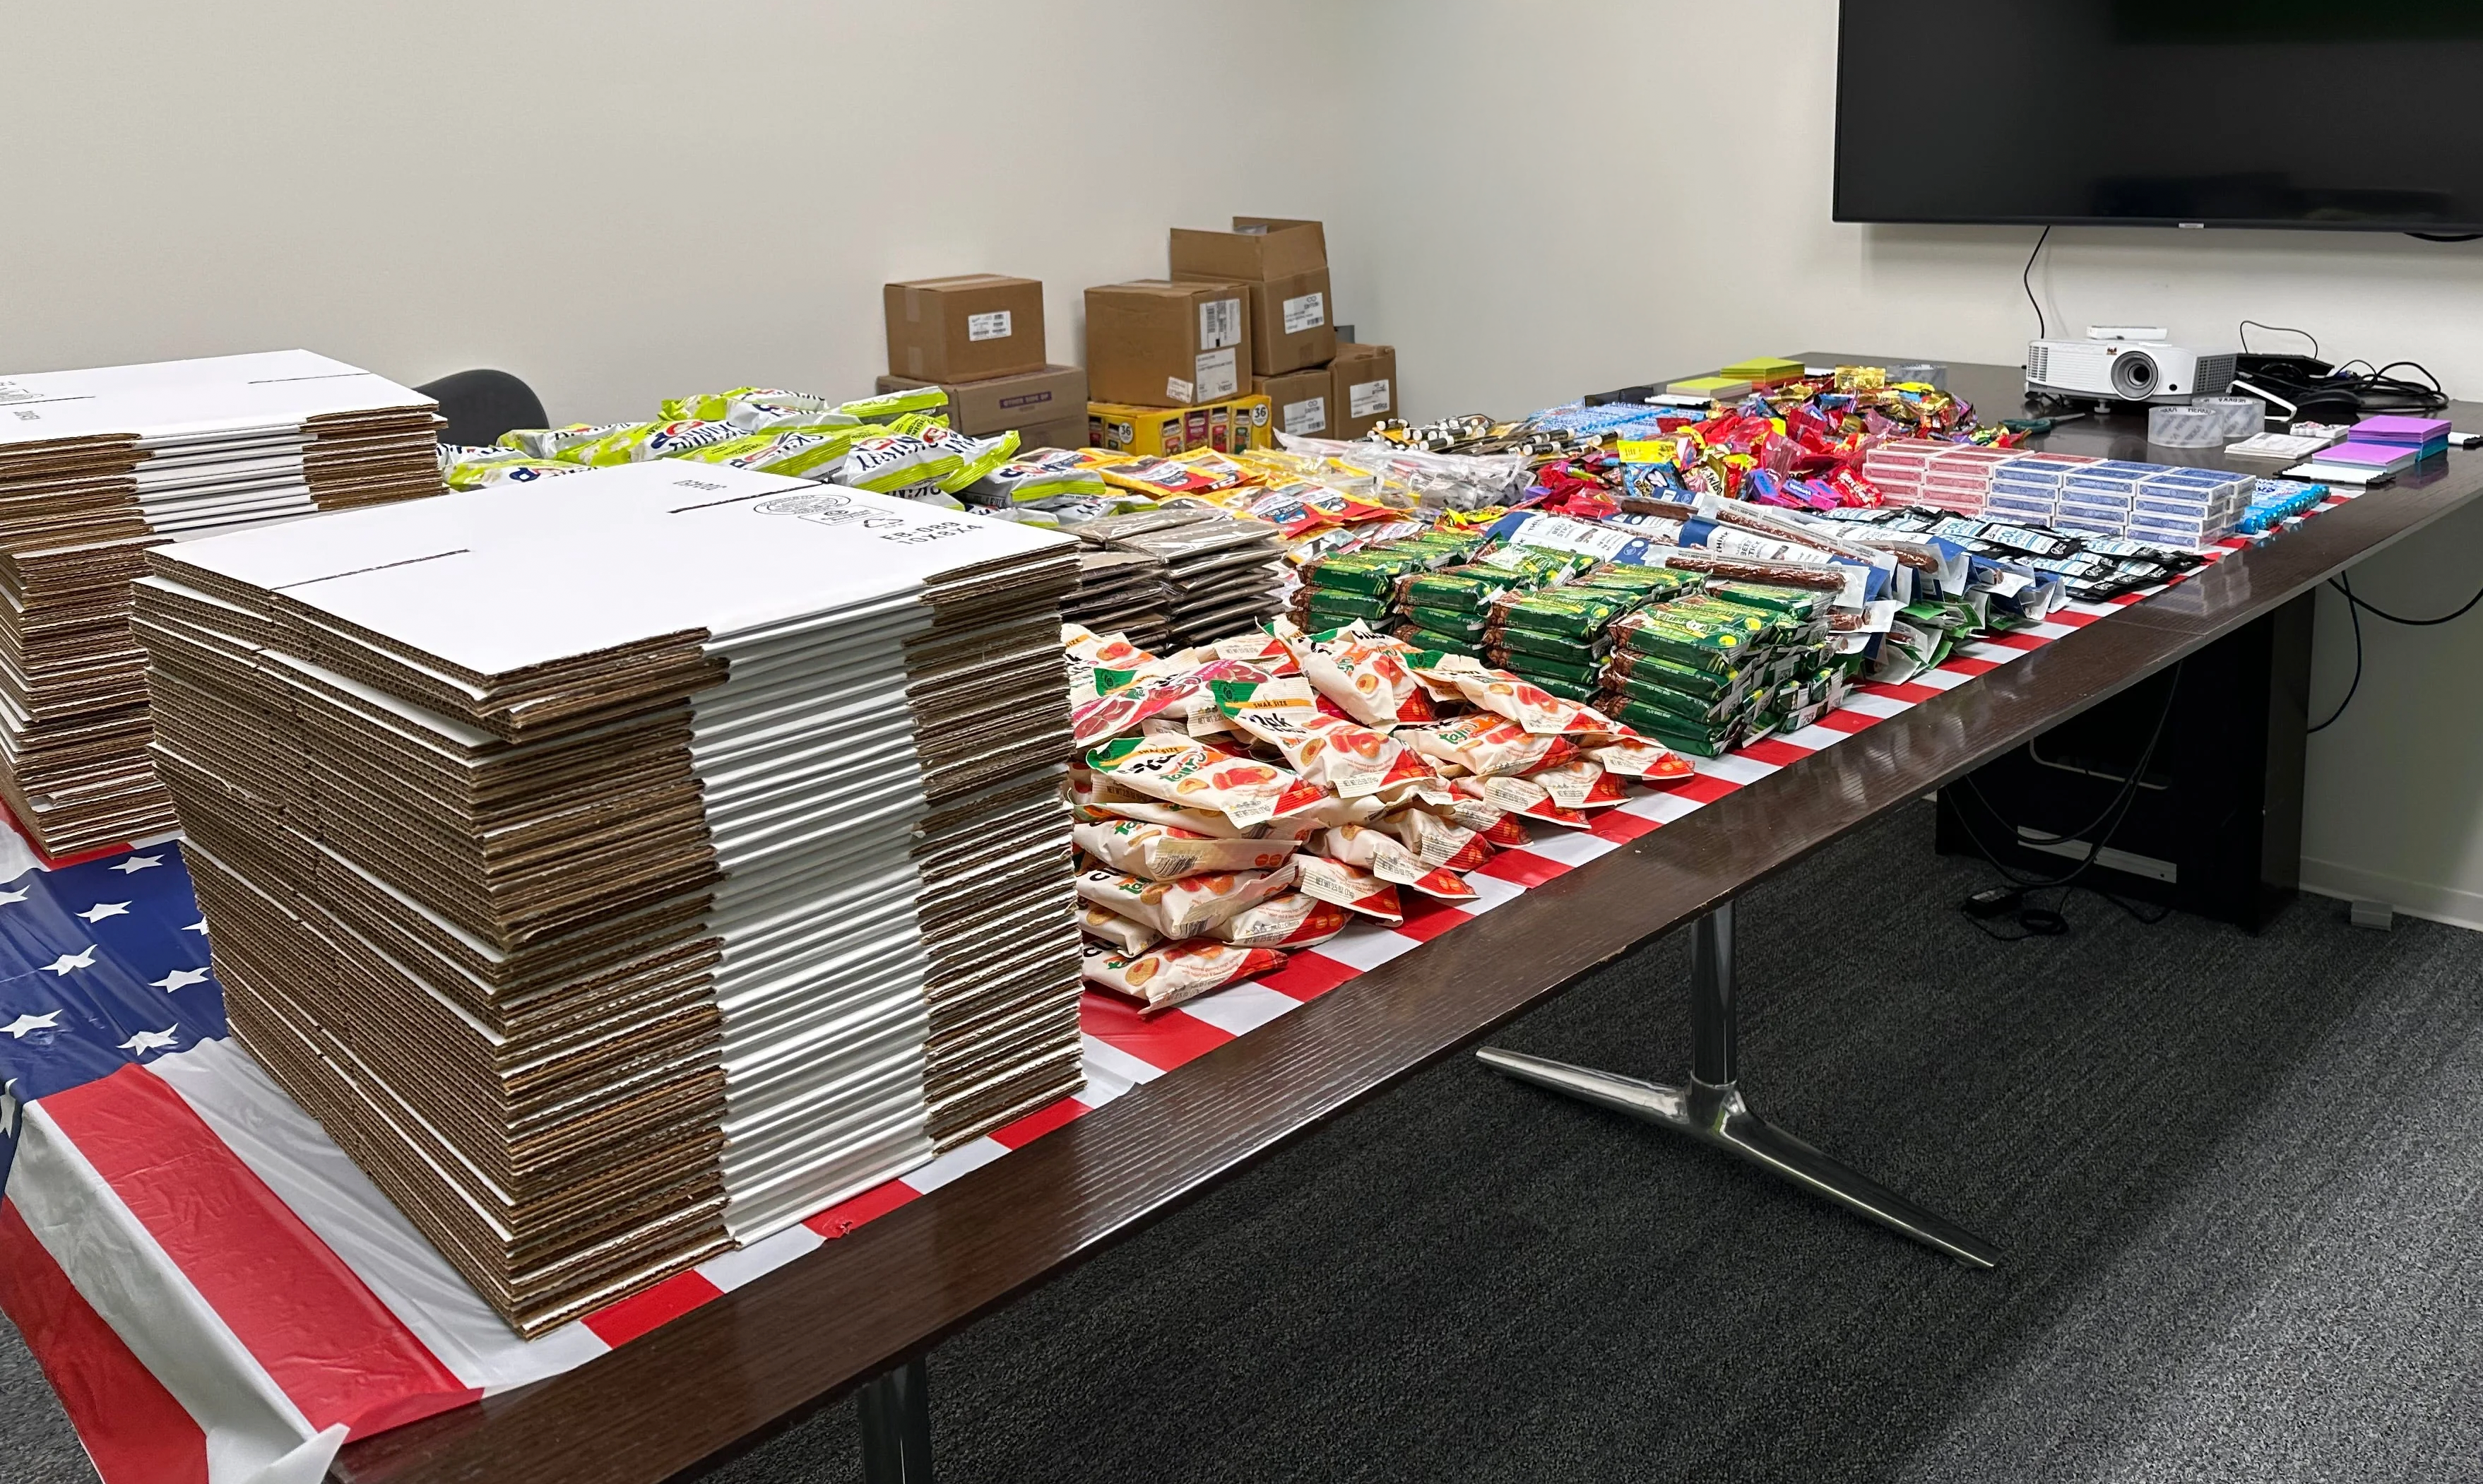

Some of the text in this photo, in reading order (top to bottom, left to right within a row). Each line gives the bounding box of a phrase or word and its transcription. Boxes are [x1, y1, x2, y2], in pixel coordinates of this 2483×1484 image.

[1255, 407, 1267, 419] 36
[1121, 425, 1131, 435] 36
[880, 521, 961, 541] EB-089
[897, 523, 985, 545] 10X8X4
[1162, 747, 1179, 755] SIZE
[1315, 876, 1324, 884] NET
